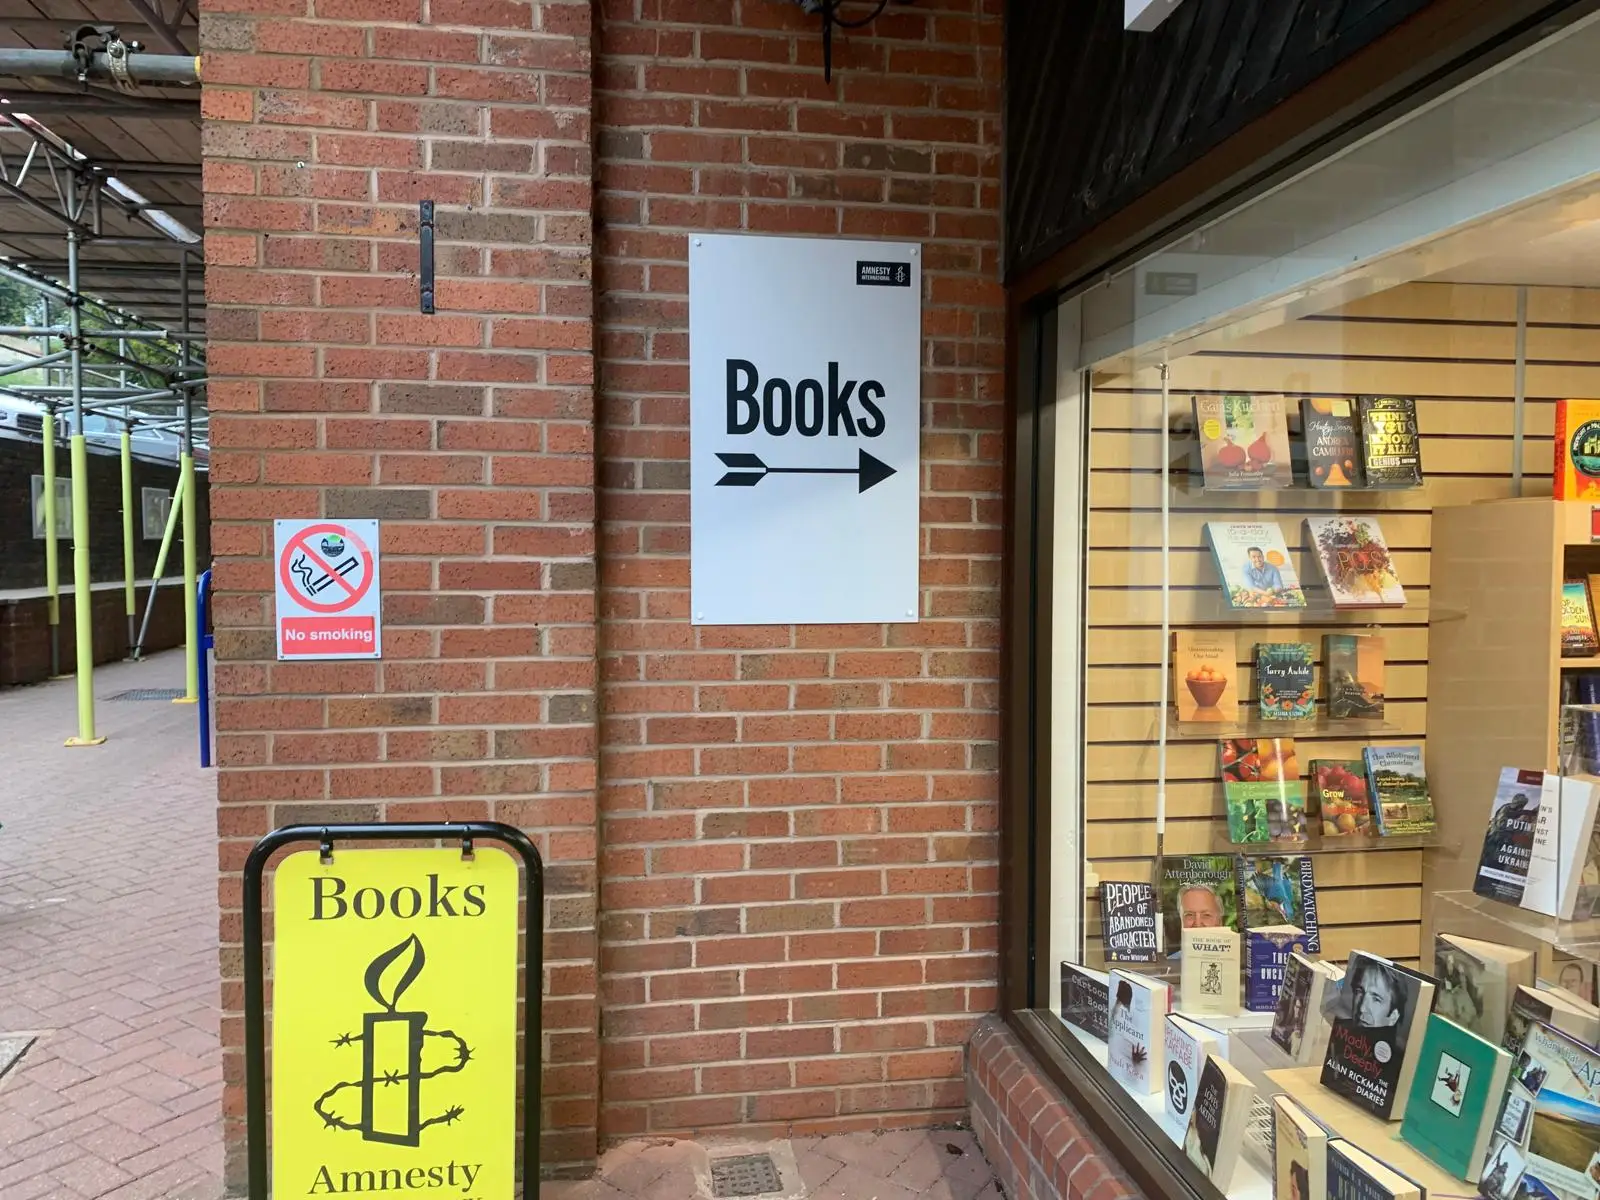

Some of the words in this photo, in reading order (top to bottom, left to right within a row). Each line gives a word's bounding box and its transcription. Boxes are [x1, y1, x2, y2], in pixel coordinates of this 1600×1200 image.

[861, 266, 890, 275] AMNESTY
[726, 359, 886, 437] Books
[1374, 421, 1406, 434] YOU
[1370, 434, 1413, 444] KNOW
[1372, 445, 1386, 454] IT
[1373, 457, 1401, 466] GENIUS
[285, 628, 305, 641] No
[310, 628, 373, 643] smoking
[1264, 664, 1286, 677] Tarry
[1322, 789, 1344, 798] Grow
[1183, 859, 1212, 870] David
[1164, 869, 1231, 880] Attenborough
[308, 873, 486, 920] Books
[1106, 884, 1151, 914] PEOPLE
[1137, 903, 1148, 914] OF
[1300, 861, 1319, 951] BIRDWATCHING
[1109, 915, 1154, 935] ABANDONED
[1109, 930, 1156, 949] CHARACTER
[1192, 943, 1231, 952] WHAT?
[1272, 952, 1287, 964] THE
[1261, 968, 1284, 980] UNCA
[1071, 975, 1108, 1000] Cartoon
[1120, 1008, 1132, 1021] The
[1344, 1045, 1382, 1078] Deeply
[1326, 1058, 1347, 1076] ALAN
[1348, 1070, 1387, 1097] RICKMAN
[1379, 1079, 1389, 1088] THE
[1356, 1086, 1385, 1106] DIARIES
[306, 1160, 482, 1194] Amnesty
